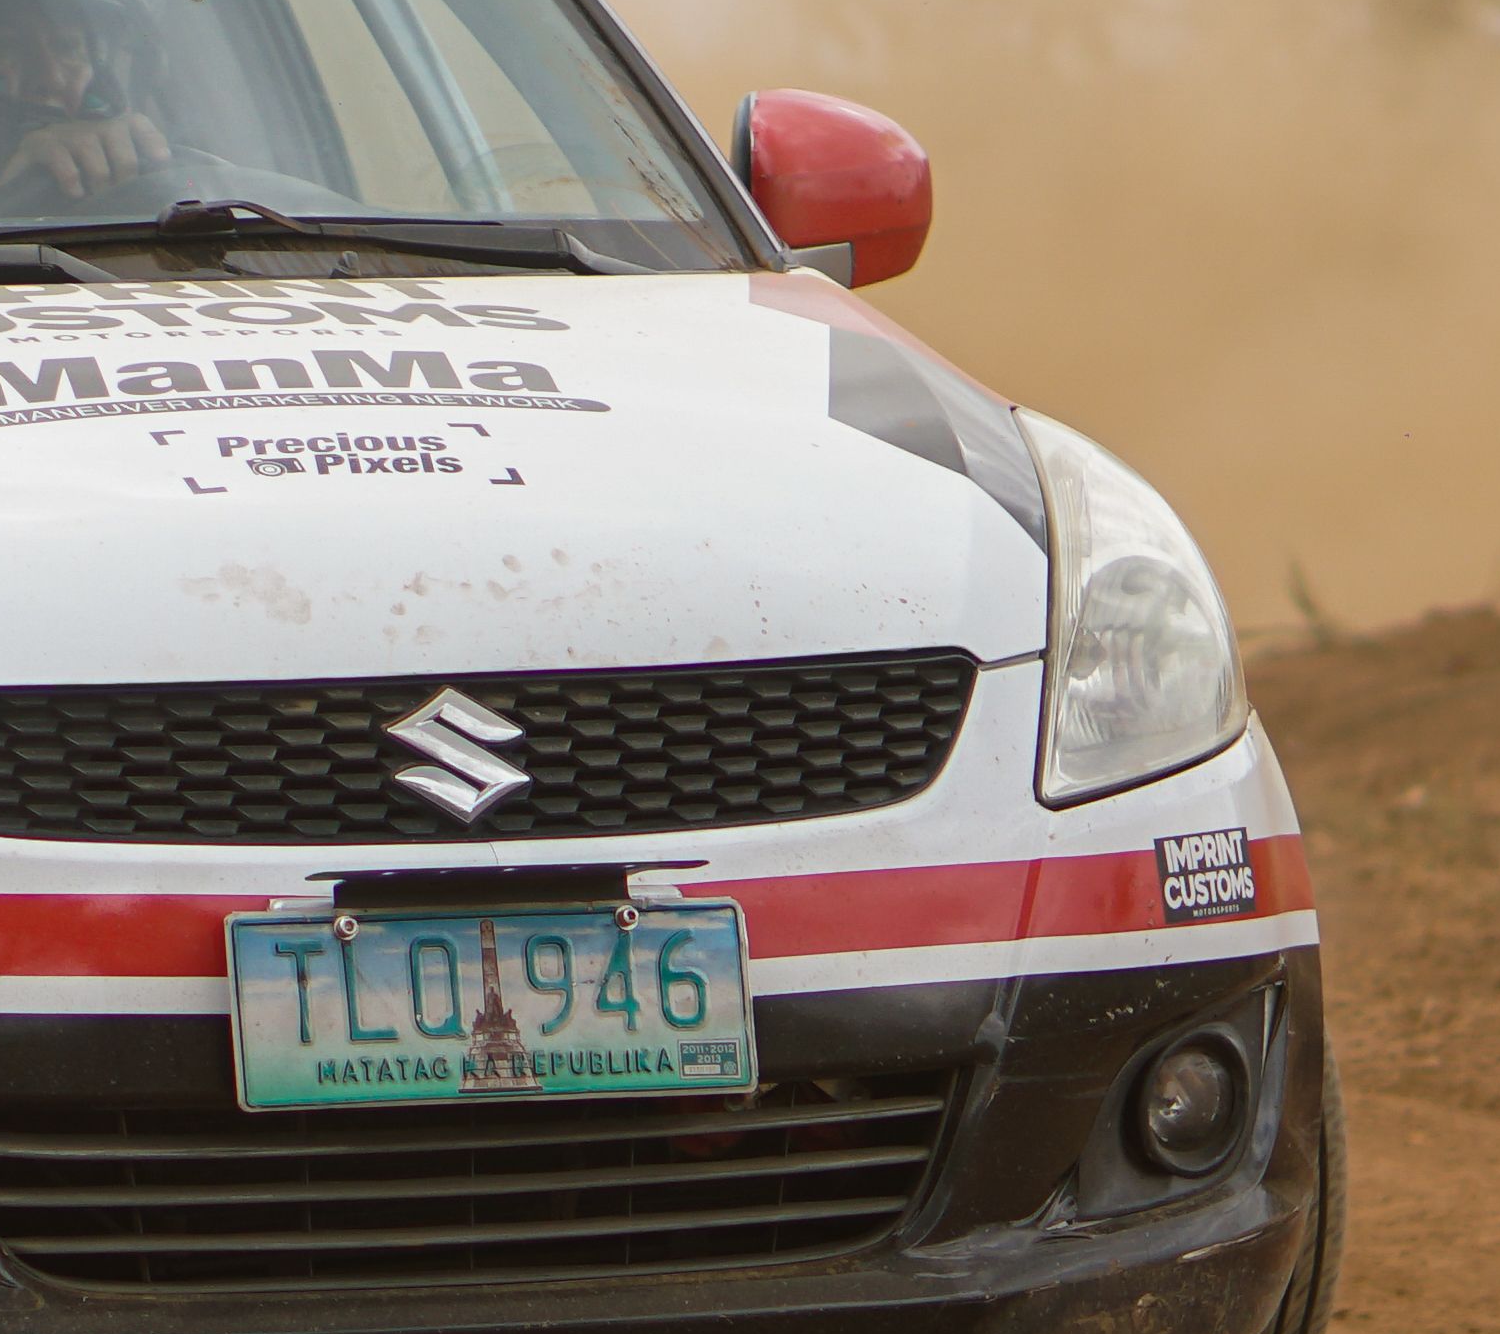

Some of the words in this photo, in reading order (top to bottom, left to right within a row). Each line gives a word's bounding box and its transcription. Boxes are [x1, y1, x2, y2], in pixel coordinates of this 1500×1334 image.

[7, 327, 403, 344] MOTORSPORTS
[198, 393, 404, 409] MARKETING
[412, 394, 582, 410] NETWORK
[216, 432, 448, 458] Precious
[314, 452, 465, 475] Pixels
[1163, 830, 1244, 874] IMPRINT
[1163, 866, 1255, 910] CUSTOMS
[522, 928, 710, 1037] 946
[316, 1055, 449, 1084] MATATAG
[511, 1047, 675, 1078] REPUBLIKA
